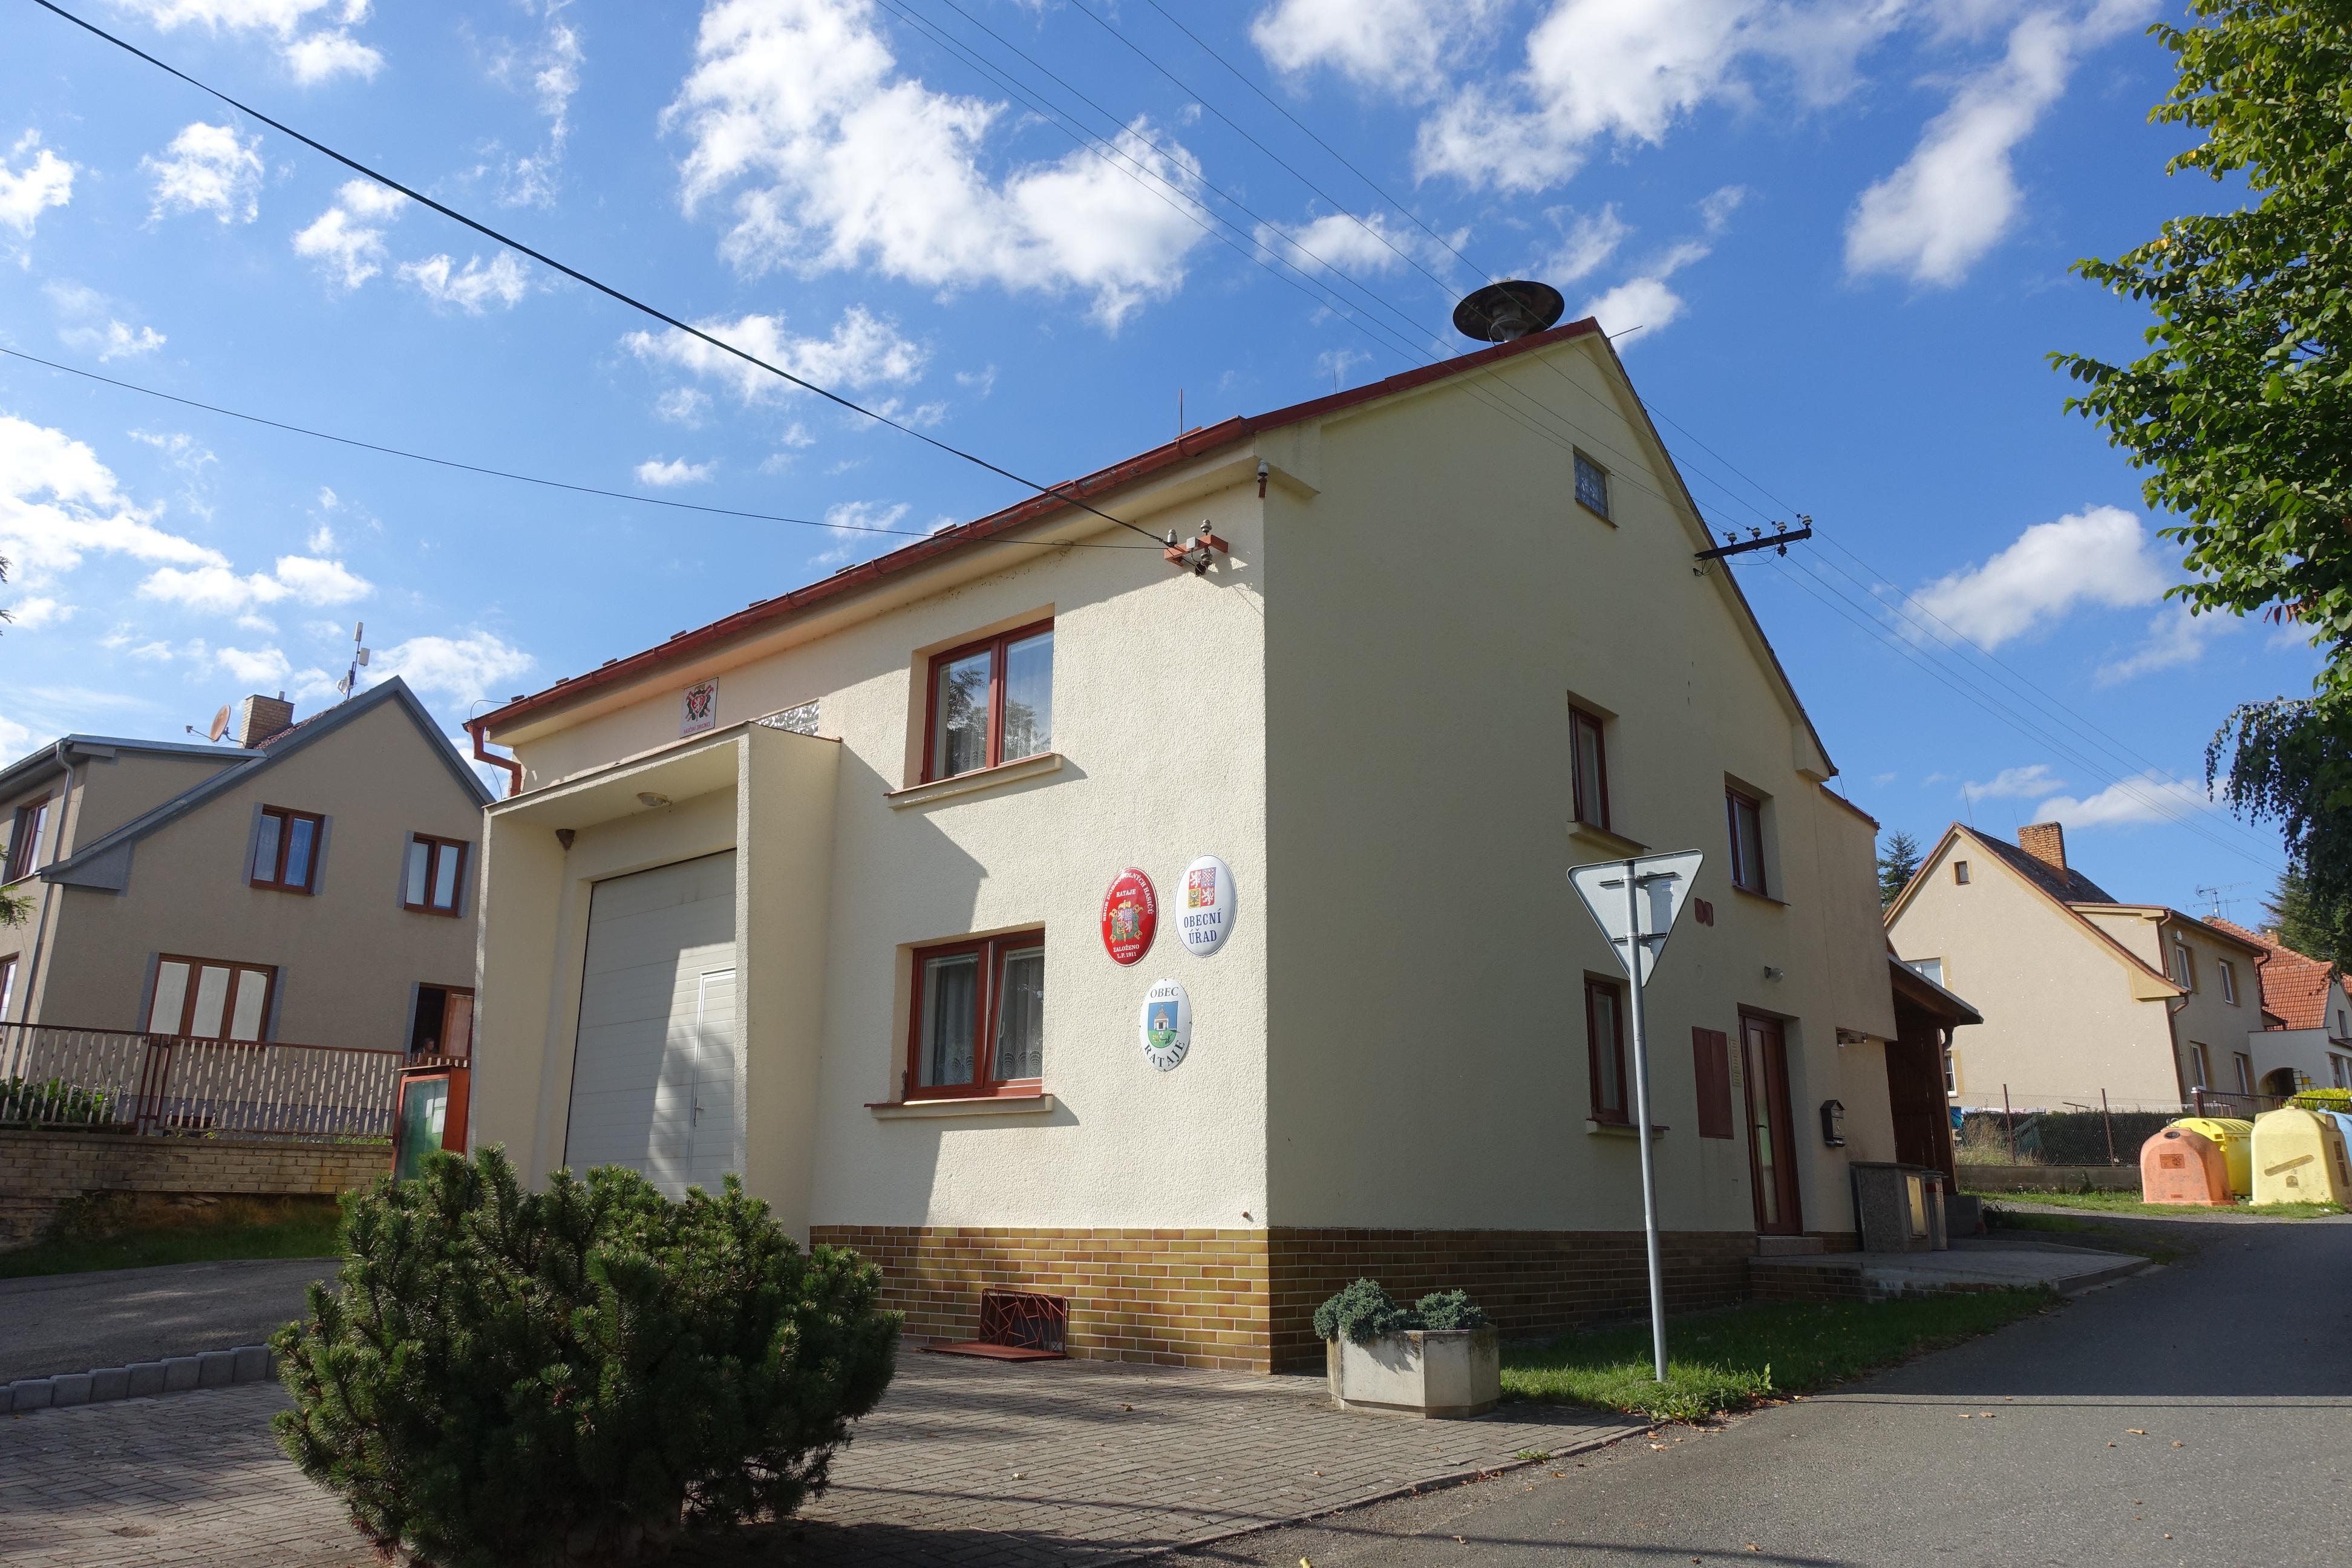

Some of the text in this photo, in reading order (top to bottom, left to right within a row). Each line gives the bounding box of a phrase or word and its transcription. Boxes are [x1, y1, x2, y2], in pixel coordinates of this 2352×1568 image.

[1116, 889, 1136, 897] RATAJE
[1143, 887, 1154, 914] HASIČŮ
[1184, 908, 1221, 928] OBECNÍ
[1189, 928, 1217, 944] ÚŘAD
[1113, 944, 1140, 953] ZALOŽENO
[1151, 987, 1179, 998] OBEC
[1145, 1040, 1185, 1067] RATAJE
